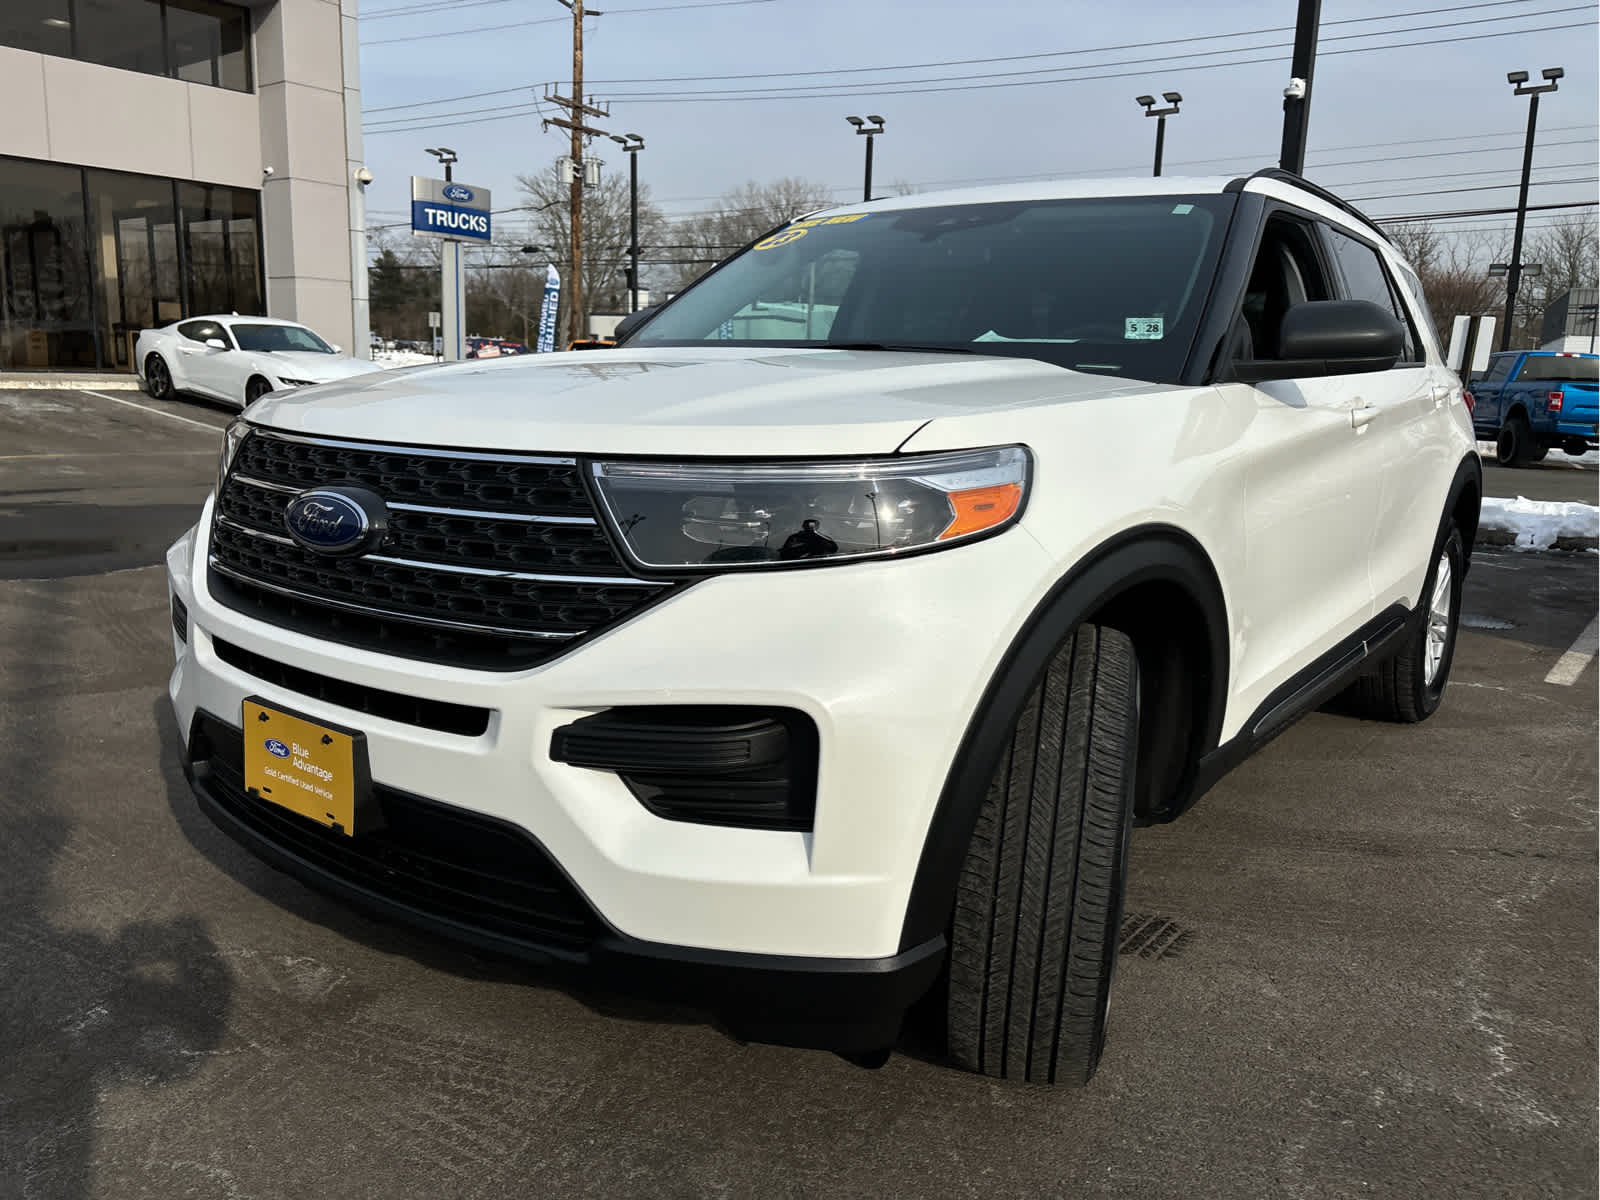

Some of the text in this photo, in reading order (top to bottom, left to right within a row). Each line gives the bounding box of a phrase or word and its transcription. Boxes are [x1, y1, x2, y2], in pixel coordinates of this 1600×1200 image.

[424, 208, 488, 232] TRUCKS
[1130, 323, 1160, 333] 5 28
[298, 502, 344, 537] Ford
[292, 742, 309, 759] Blue
[293, 756, 333, 781] Advantage
[264, 766, 333, 800] Gold Certified Used Vehicle
